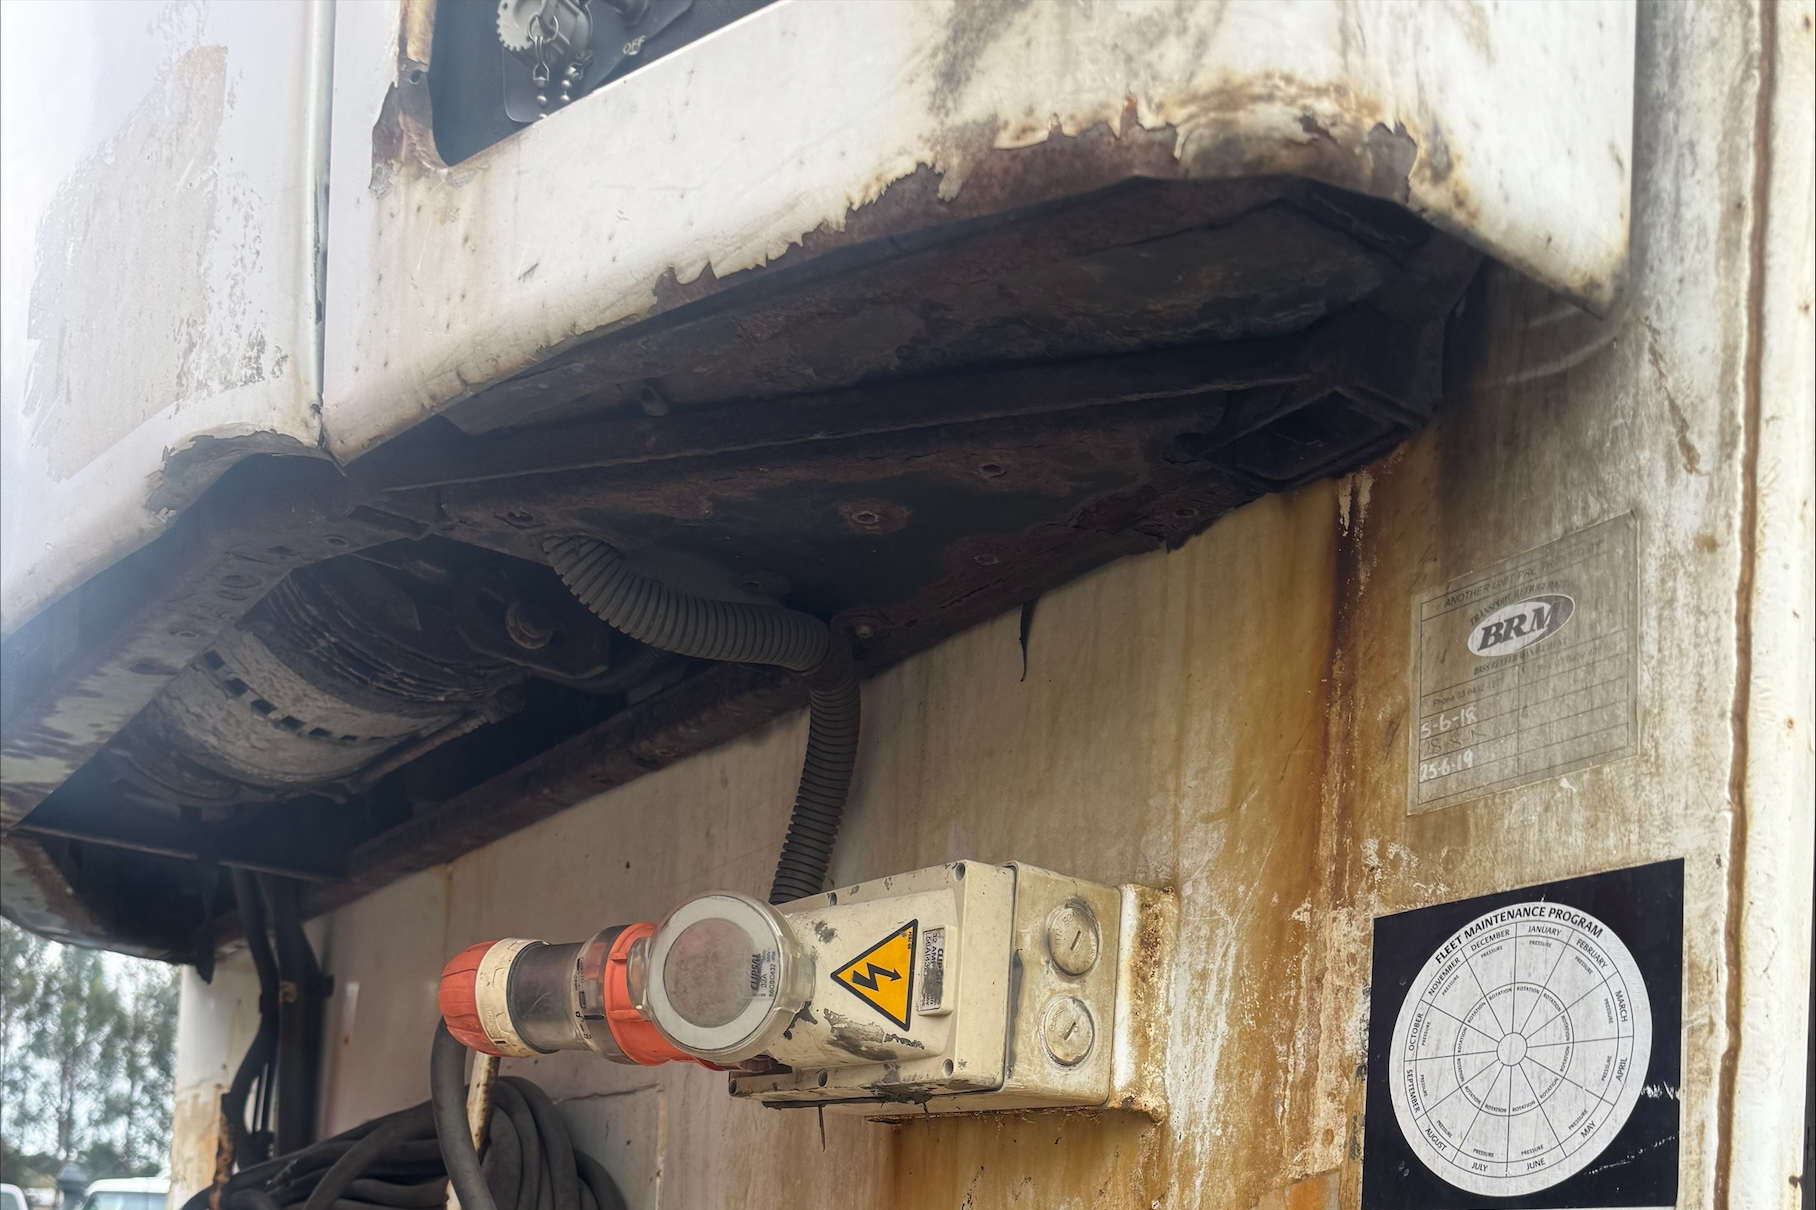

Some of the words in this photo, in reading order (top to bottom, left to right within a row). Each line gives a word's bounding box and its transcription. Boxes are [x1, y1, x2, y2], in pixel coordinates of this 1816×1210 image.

[1444, 583, 1491, 608] ANOTHER
[1492, 574, 1516, 590] UNIT
[1476, 601, 1560, 652] BRM
[1420, 704, 1477, 739] 5-6-18
[1435, 935, 1462, 964] FLEET
[1464, 906, 1546, 940] MAINTENANCE
[1548, 907, 1604, 939] PROGRAM
[1470, 929, 1511, 952] DECEMBER
[1528, 925, 1562, 937] JANUARY
[1480, 945, 1503, 960] PRESSURE
[1528, 940, 1552, 948] PRESSURE
[1576, 938, 1608, 969] FEBRUARY
[750, 953, 761, 992] CLIPSAL
[1428, 957, 1461, 996] NOVEMBER
[1574, 955, 1594, 976] PRESSURE
[1442, 974, 1460, 996] PRESSURE
[1488, 987, 1513, 1001] ROTATION
[1516, 986, 1540, 995] ROTATION
[1467, 1001, 1487, 1024] ROTATION
[1543, 992, 1562, 1013] ROTATION
[1604, 998, 1614, 1025] PRESSURE
[1614, 990, 1628, 1023] MARCH
[1408, 1012, 1424, 1051] OCTOBER
[1421, 1021, 1432, 1046] PRESSURE
[1561, 1015, 1570, 1042] ROTATION
[1457, 1027, 1468, 1054] ROTATION
[1456, 1058, 1465, 1082] ROTATION
[1560, 1046, 1570, 1072] ROTATION
[1601, 1055, 1612, 1082] PRESSURE
[1616, 1057, 1628, 1082] APRIL
[1406, 1068, 1421, 1114] SEPTEMBER
[1420, 1074, 1428, 1098] PRESSURE
[1464, 1085, 1482, 1106] ROTATION
[1540, 1077, 1560, 1100] ROTATION
[1484, 1104, 1508, 1113] ROTATION
[1512, 1100, 1536, 1112] ROTATION
[1436, 1120, 1452, 1138] PRESSURE
[1568, 1109, 1588, 1131] PRESSURE
[1580, 1120, 1597, 1139] MAY
[1424, 1127, 1448, 1152] AUGUST
[1520, 1144, 1544, 1156] PRESSURE
[1472, 1148, 1494, 1158] PRESSURE
[1526, 1158, 1546, 1170] JUNE
[1472, 1161, 1488, 1172] JULY
